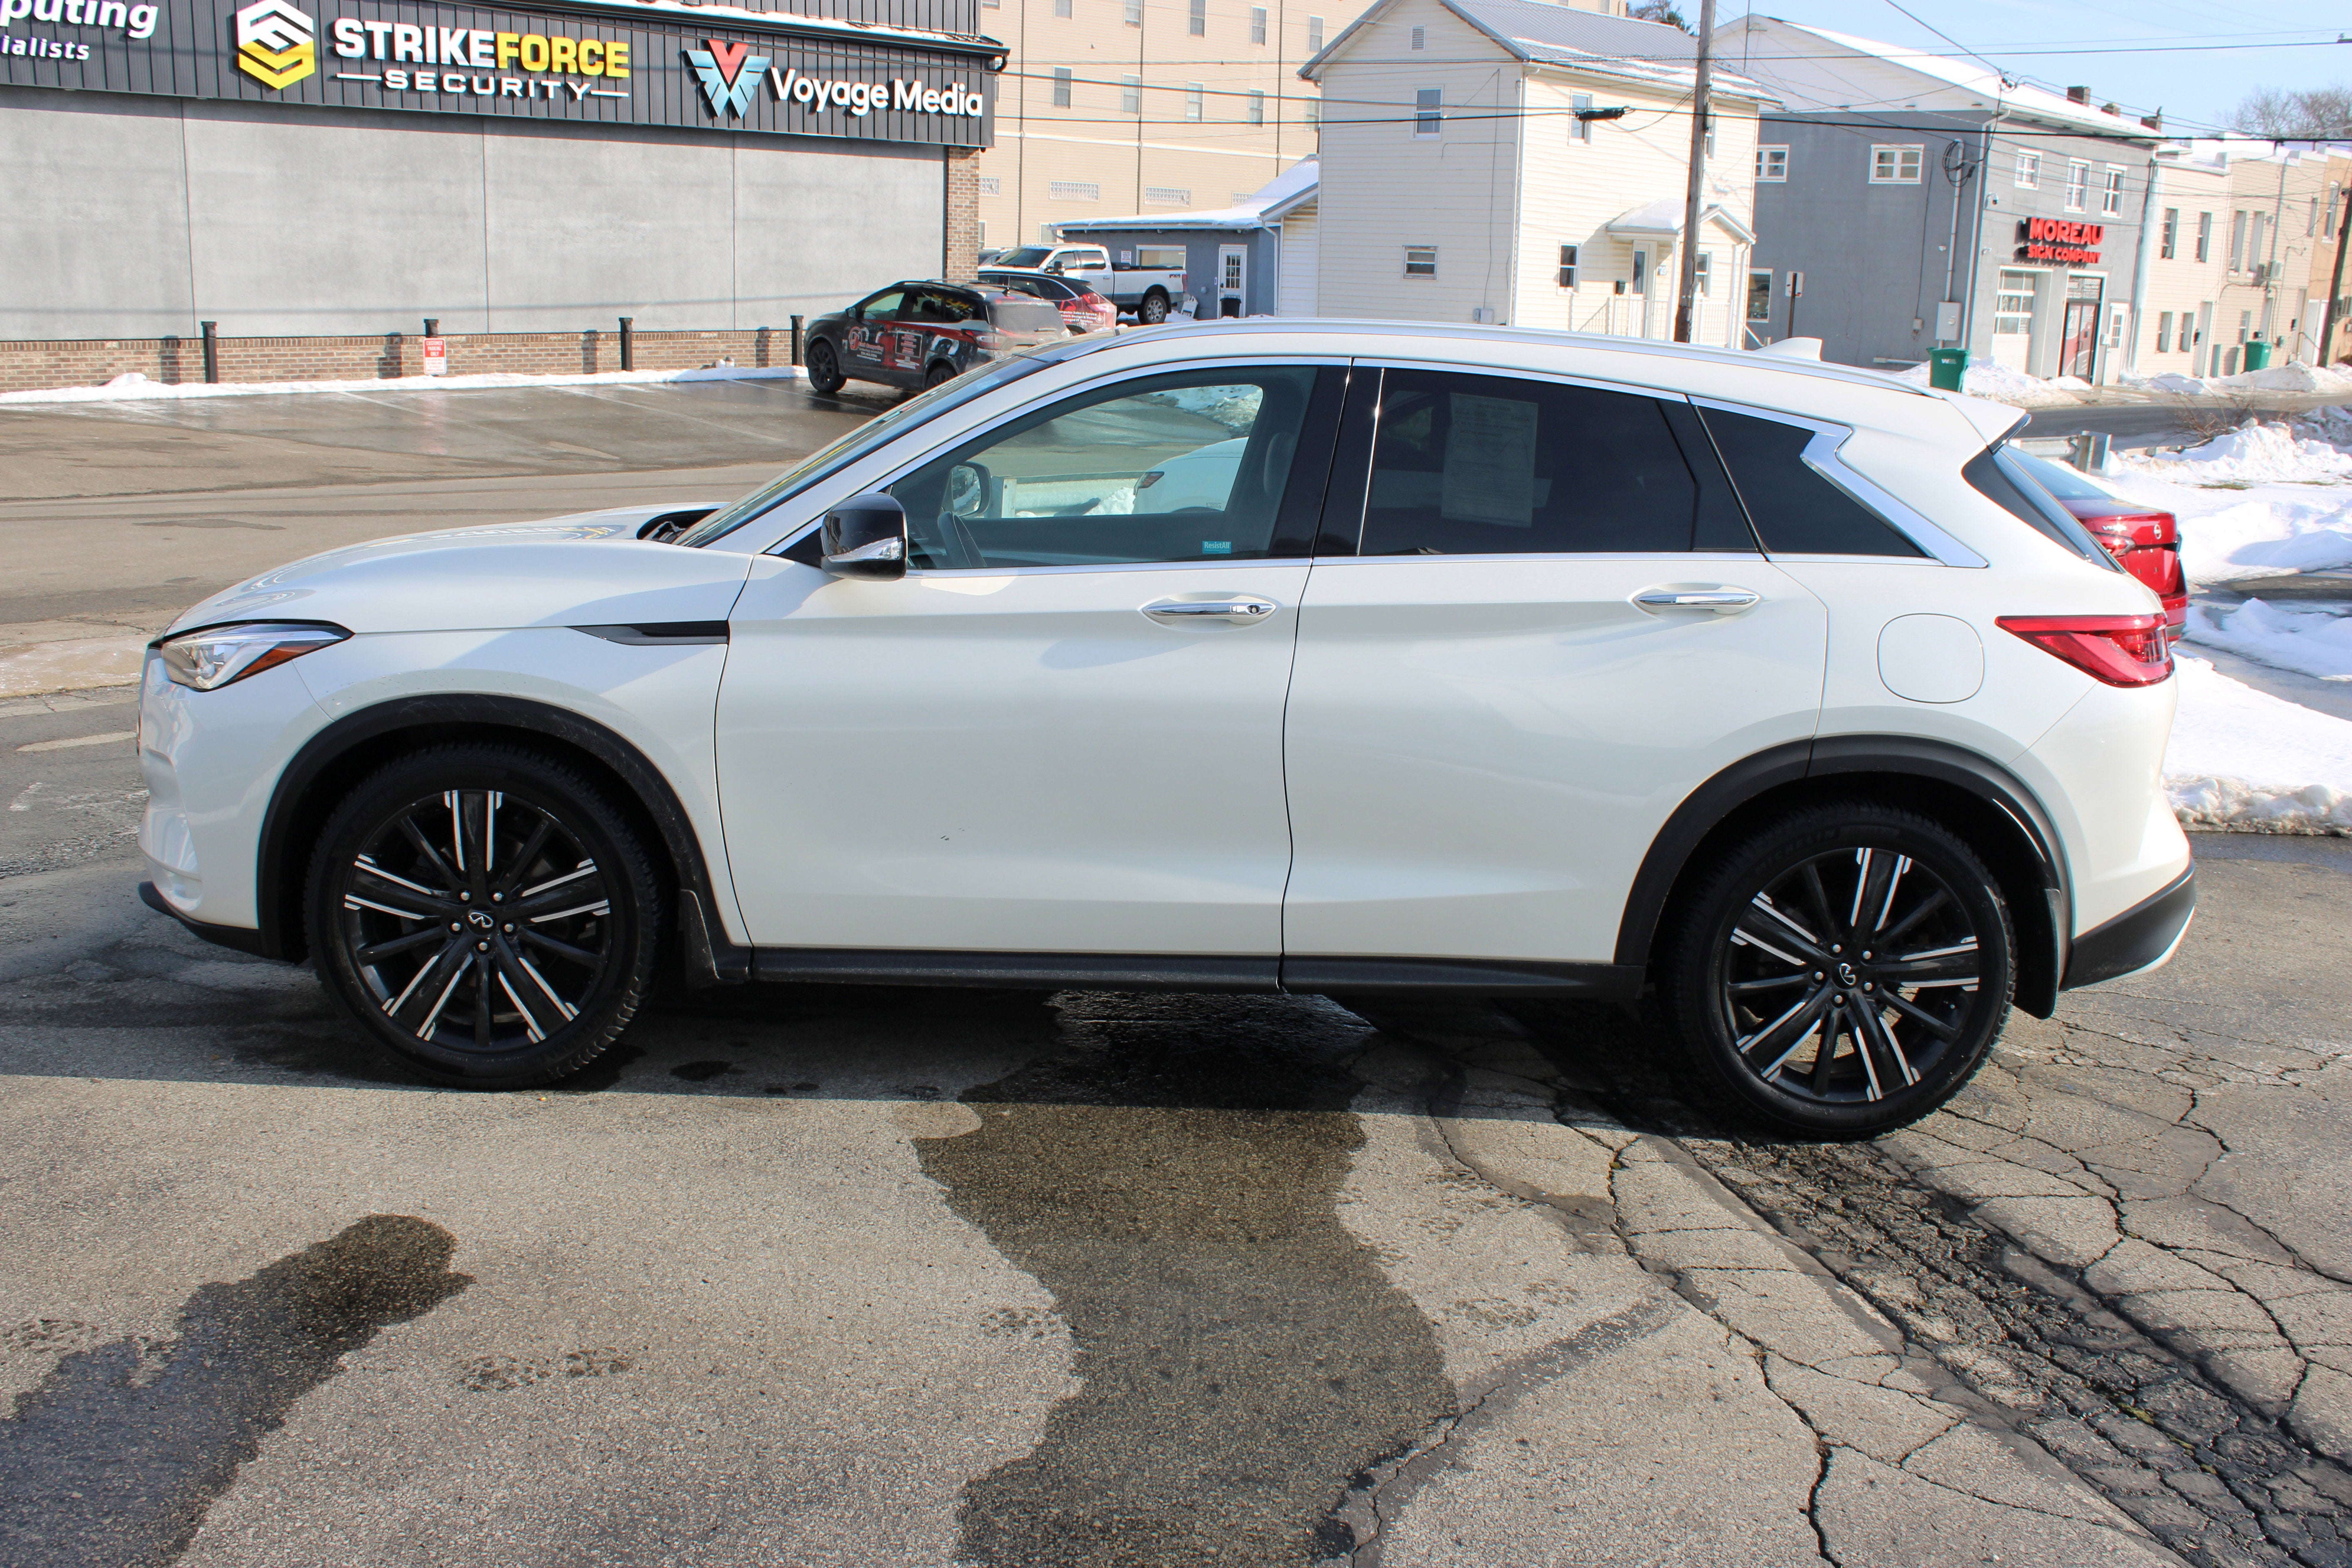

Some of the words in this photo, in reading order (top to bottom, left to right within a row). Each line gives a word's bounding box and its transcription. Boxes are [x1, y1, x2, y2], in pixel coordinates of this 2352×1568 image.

[0, 0, 159, 39] puting
[1, 34, 90, 60] ialists
[334, 17, 629, 78] STRIKEFORCE
[385, 69, 591, 100] SECURITY
[771, 67, 889, 117] Voyage
[893, 79, 983, 117] Media
[2029, 217, 2105, 245] MOREAU
[2027, 244, 2054, 259] SIGN
[2055, 247, 2102, 263] COMPANY
